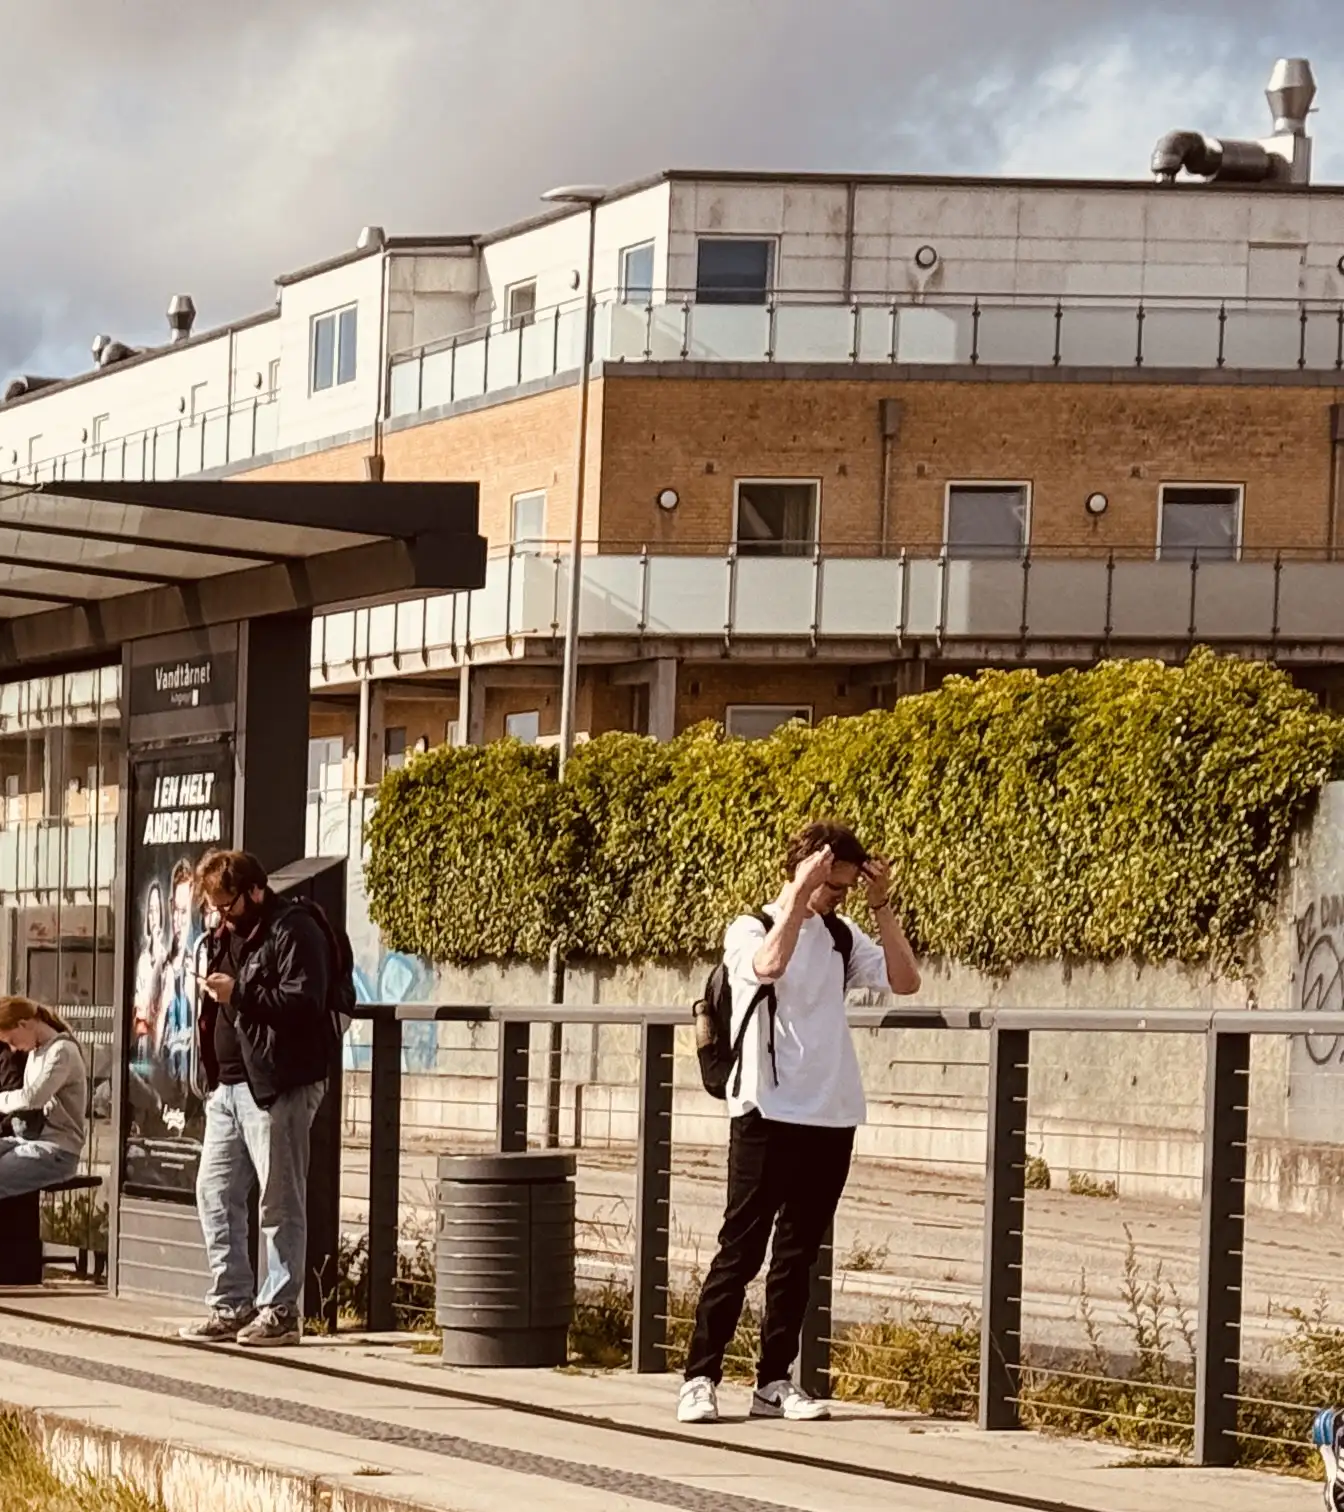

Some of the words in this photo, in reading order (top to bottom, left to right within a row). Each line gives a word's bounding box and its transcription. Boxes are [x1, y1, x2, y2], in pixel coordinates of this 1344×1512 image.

[155, 662, 212, 692] Vandtårnet
[160, 776, 180, 808] EN
[179, 772, 215, 806] HELT
[143, 812, 189, 846] ANDEN
[188, 809, 221, 843] LIGA
